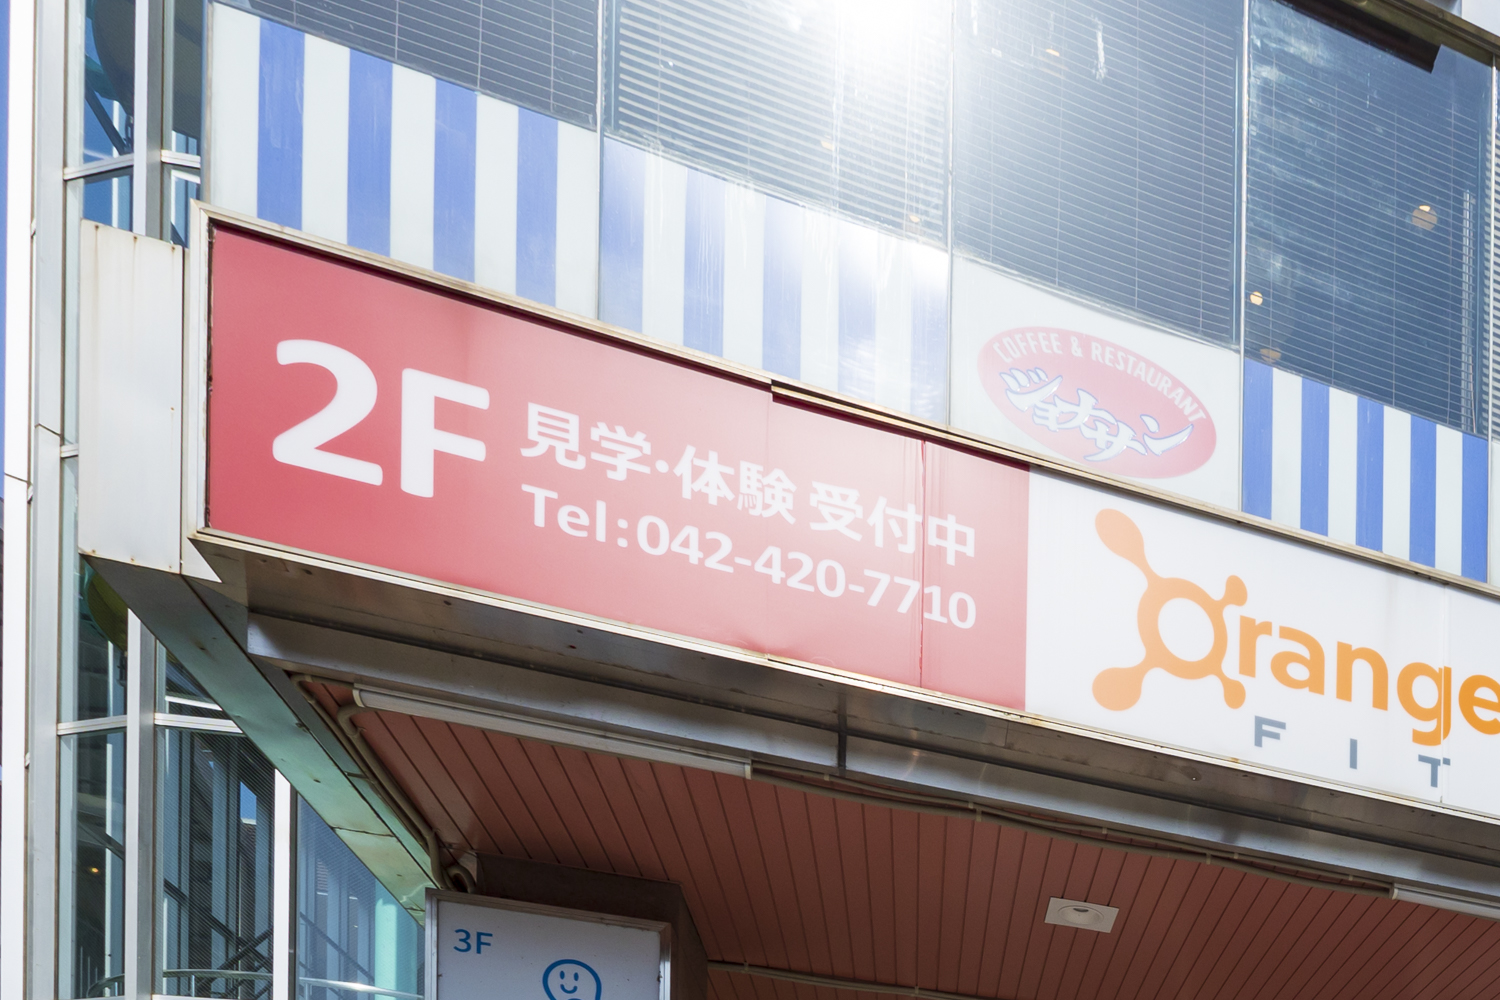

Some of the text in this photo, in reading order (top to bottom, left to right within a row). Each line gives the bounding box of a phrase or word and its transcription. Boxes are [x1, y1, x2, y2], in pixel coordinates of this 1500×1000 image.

[272, 338, 490, 498] 2F
[992, 332, 1206, 423] COFFEE & RESTAURANT
[808, 480, 976, 566] 受付中
[453, 929, 493, 954] 3F
